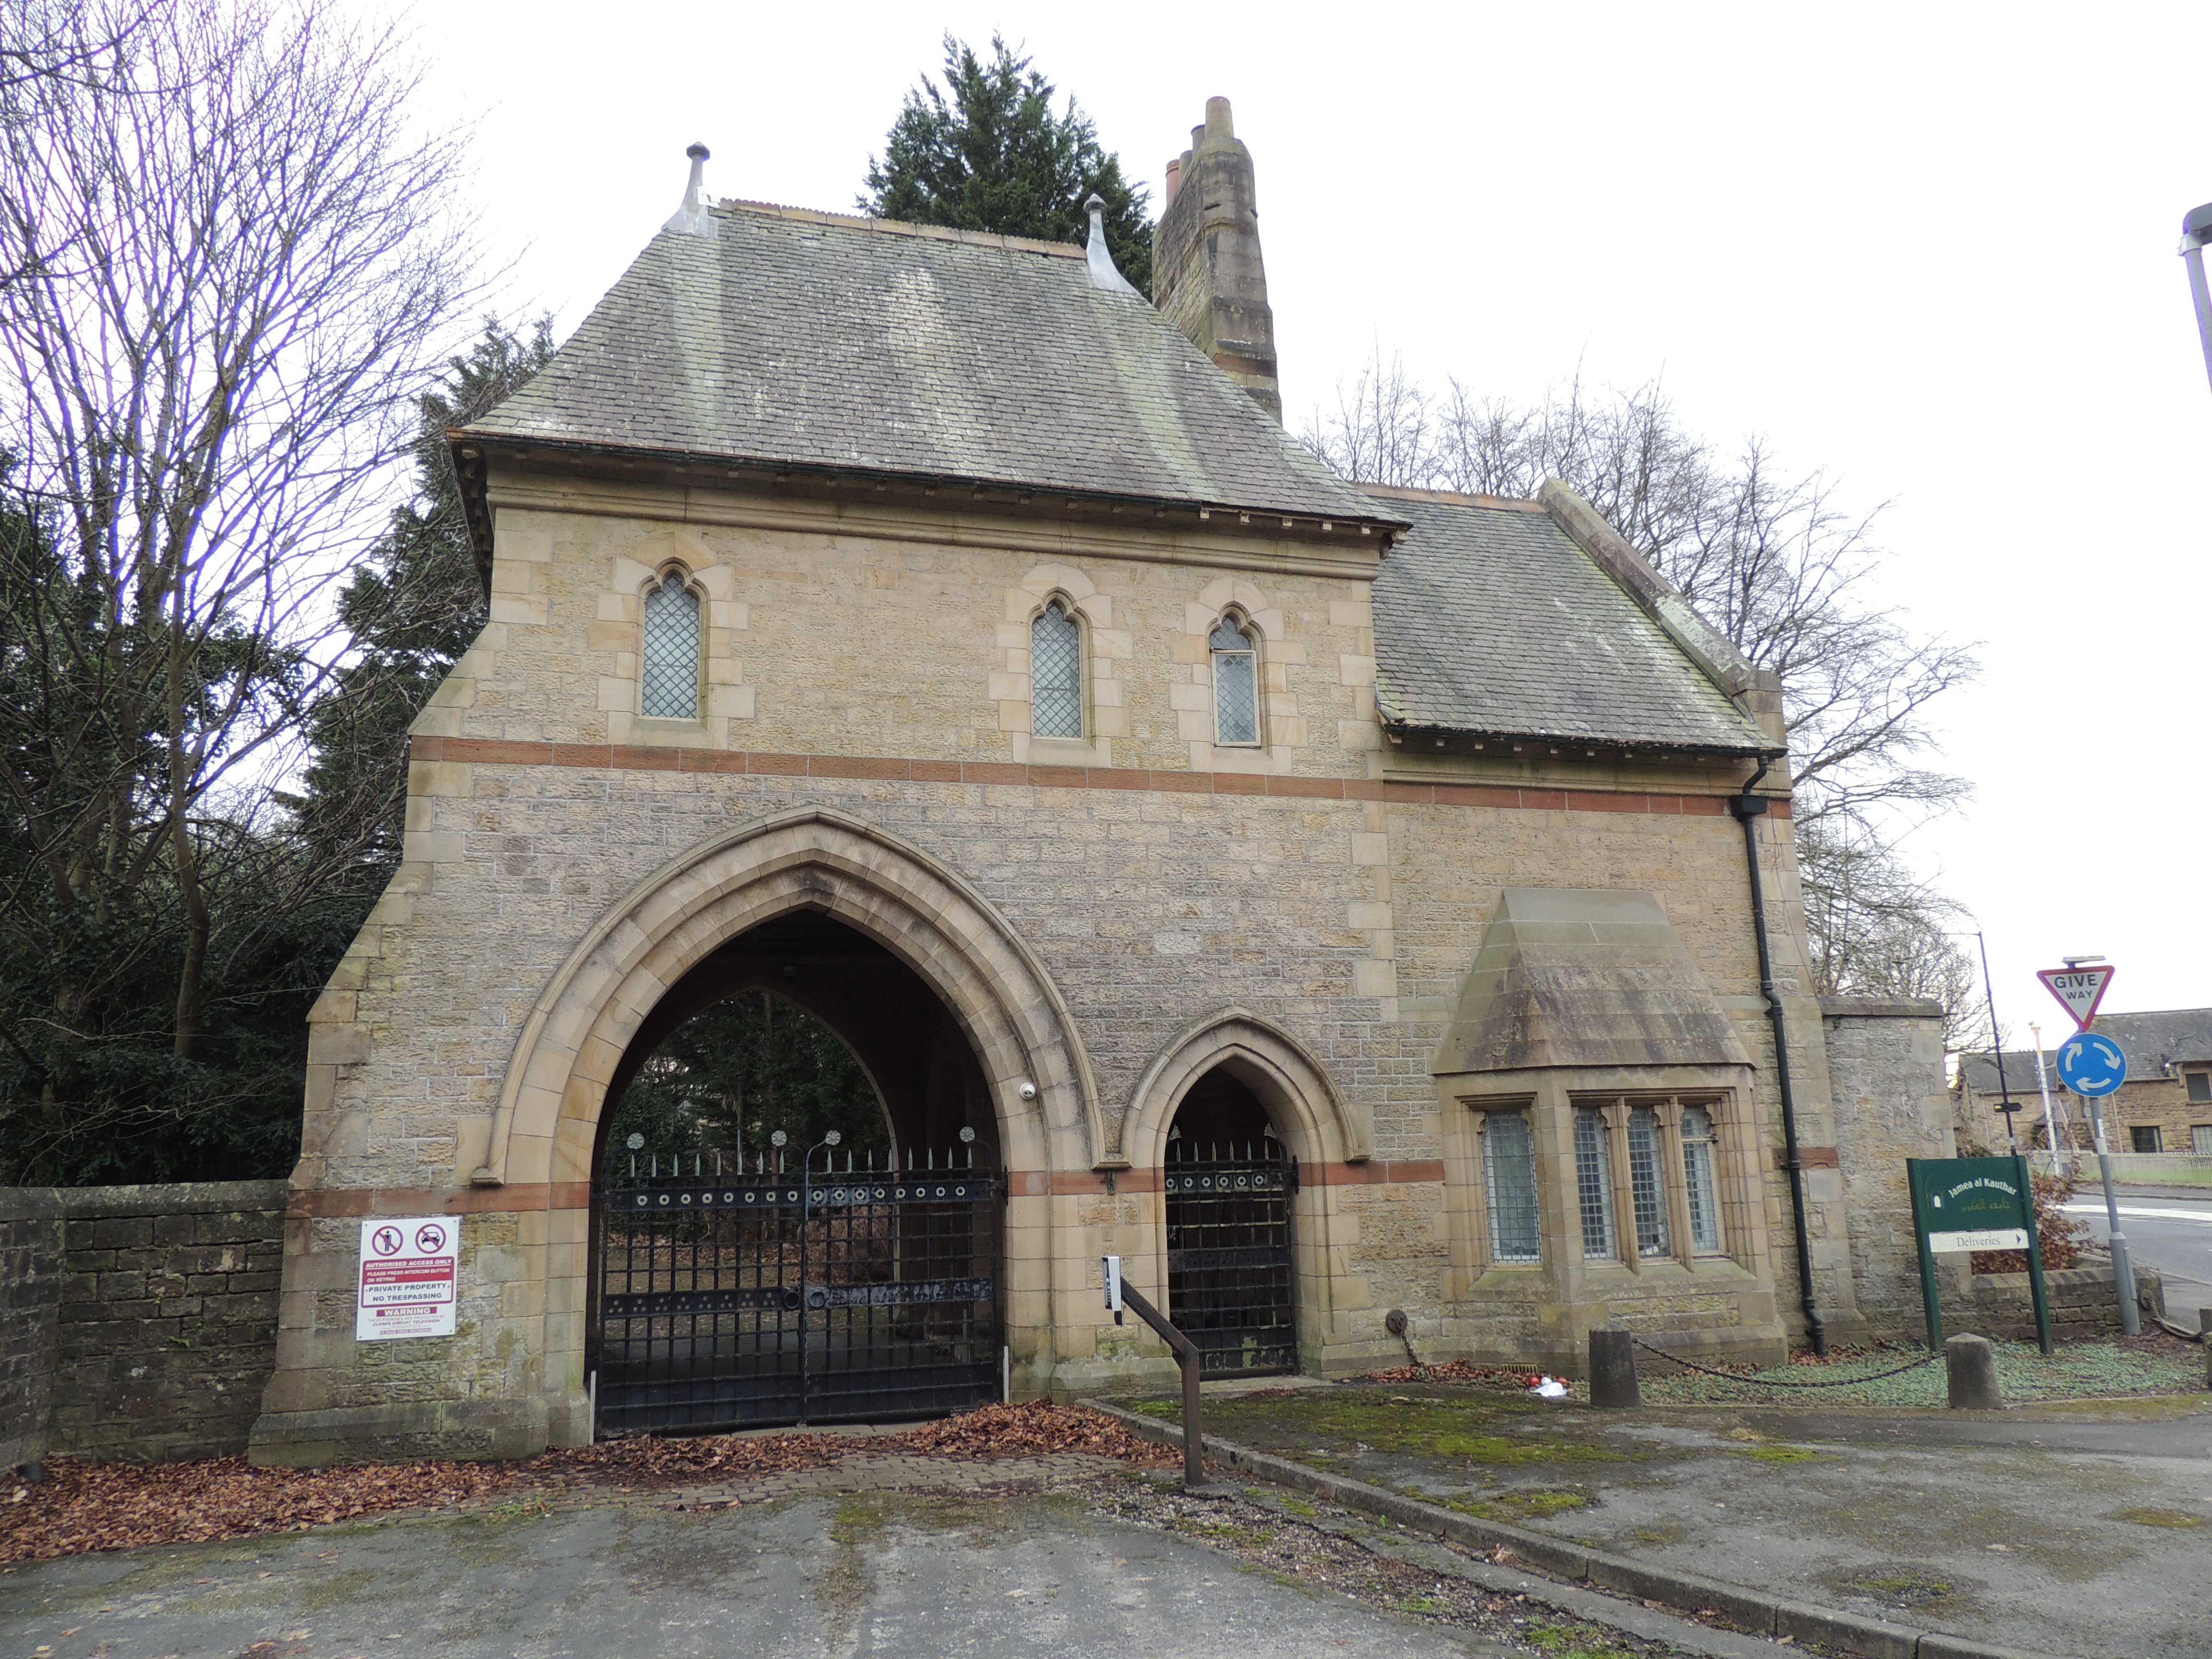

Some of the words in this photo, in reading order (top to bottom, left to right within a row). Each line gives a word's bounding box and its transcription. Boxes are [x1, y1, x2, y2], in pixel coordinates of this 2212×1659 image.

[2054, 974, 2098, 988] GIVE
[2066, 990, 2092, 999] WAY
[1948, 1181, 1973, 1198] Jamea
[1974, 1178, 1983, 1187] al
[1984, 1178, 2017, 1195] Kauthar
[1957, 1237, 2001, 1247] Deliveries
[387, 1293, 442, 1301] TRESPASSING
[385, 1308, 431, 1316] WARNING
